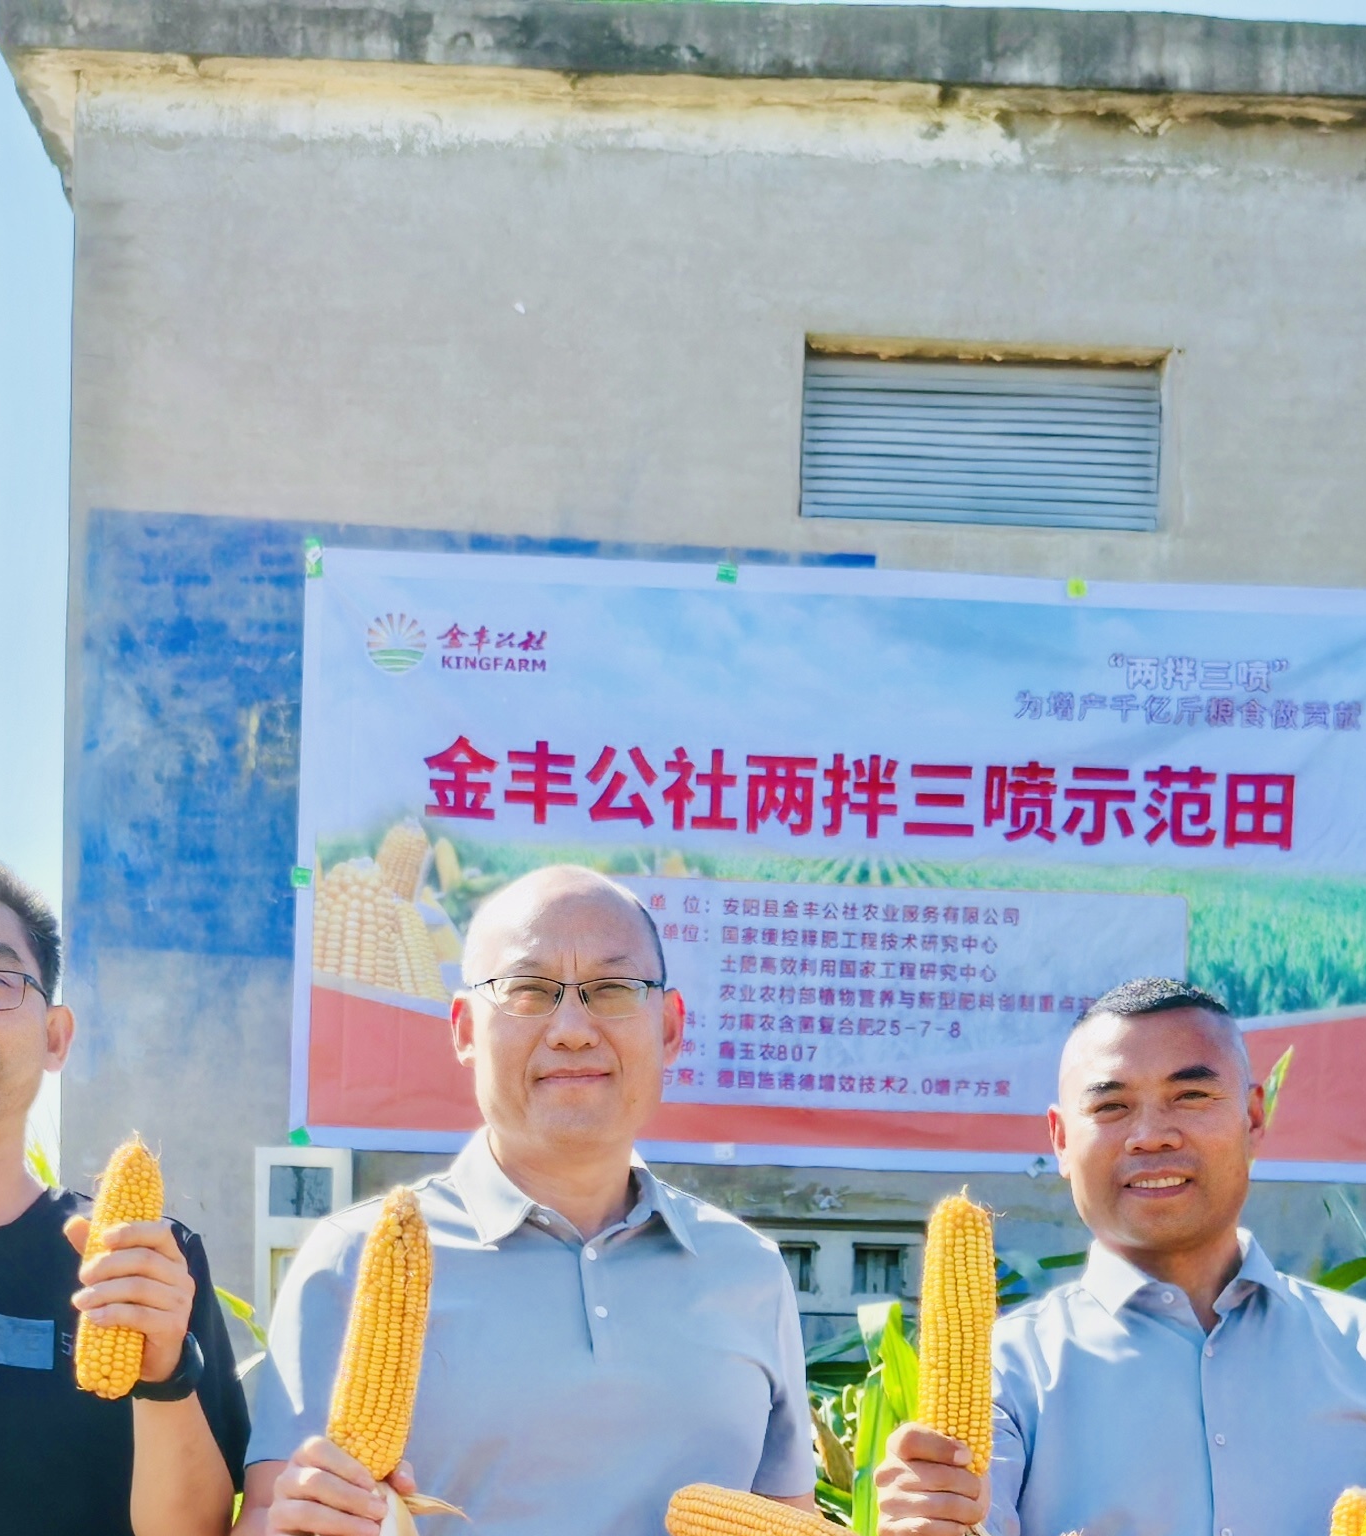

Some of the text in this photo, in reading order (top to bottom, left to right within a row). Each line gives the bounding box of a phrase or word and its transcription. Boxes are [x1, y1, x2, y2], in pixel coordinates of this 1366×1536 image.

[437, 623, 547, 655] 金丰公社
[441, 655, 546, 672] KINGFARM
[1014, 690, 1362, 731] 为增产千亿斤粮食做贡献
[422, 734, 1296, 852] 金丰公社两拌三喷示范田
